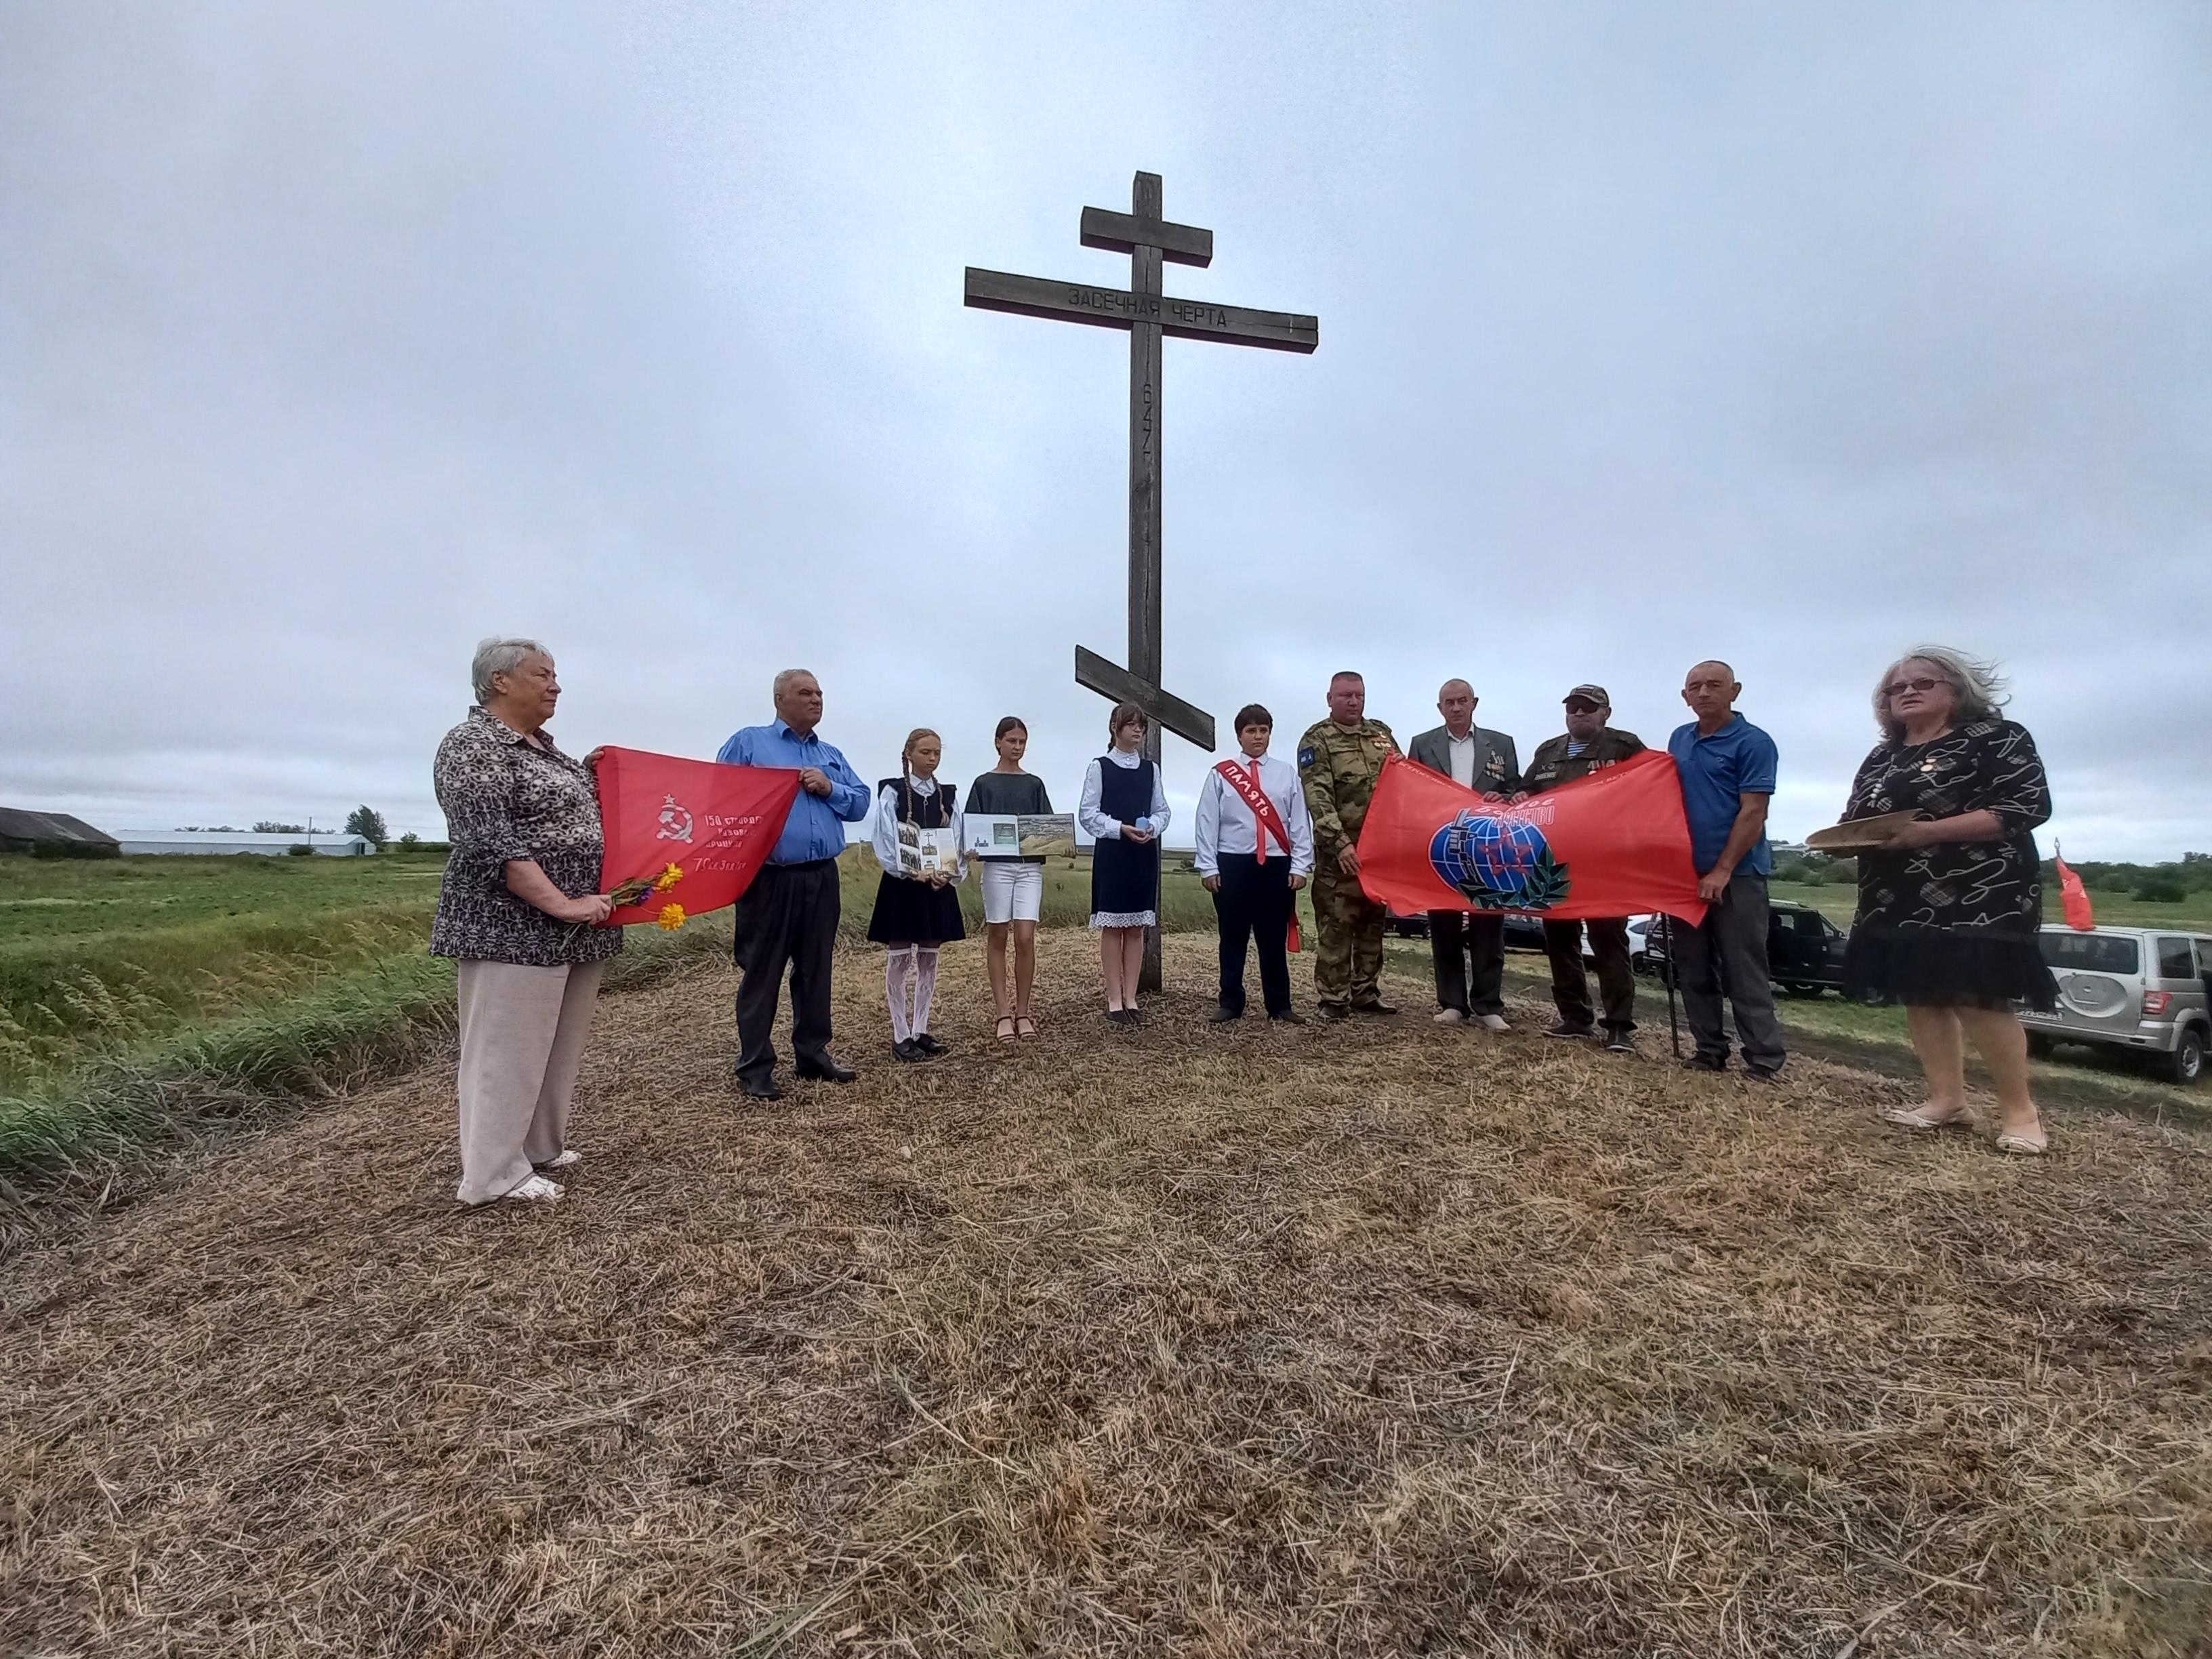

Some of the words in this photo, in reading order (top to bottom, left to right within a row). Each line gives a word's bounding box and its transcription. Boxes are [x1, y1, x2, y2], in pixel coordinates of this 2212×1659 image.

[1068, 288, 1160, 318] ЗАСЕЧНАЯ
[1172, 305, 1227, 327] ЧЕРТА
[1225, 765, 1270, 817] ПАМЯТЬ
[705, 815, 722, 826] 150
